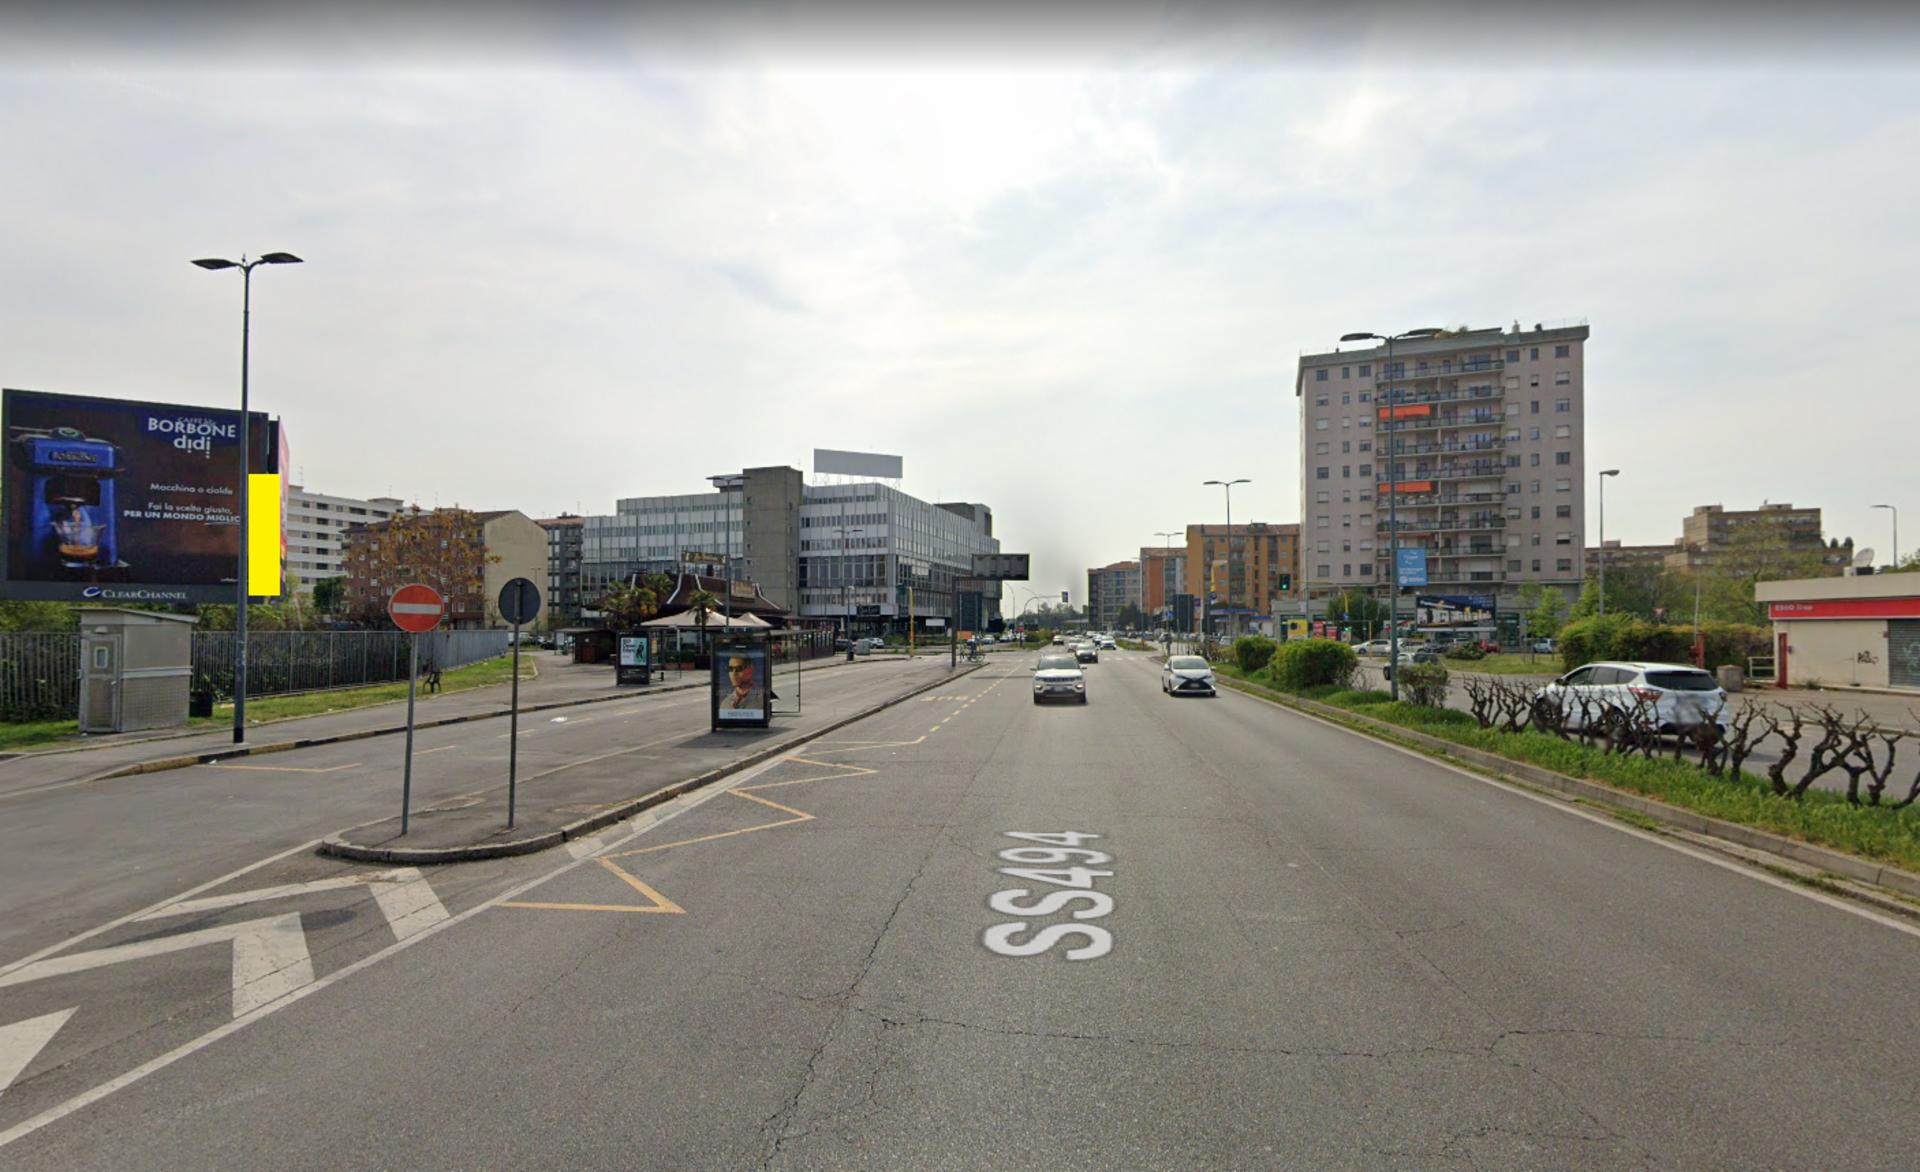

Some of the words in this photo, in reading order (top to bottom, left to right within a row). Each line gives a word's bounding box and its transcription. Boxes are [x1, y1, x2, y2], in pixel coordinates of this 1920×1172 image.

[148, 417, 237, 438] BORBONE
[150, 483, 196, 494] Macchina
[206, 486, 233, 496] cialde
[148, 502, 162, 511] Fai
[176, 504, 202, 513] scelta
[123, 509, 142, 518] PER
[144, 511, 161, 519] UN
[163, 512, 204, 521] MONDO
[984, 831, 1114, 960] SS494
